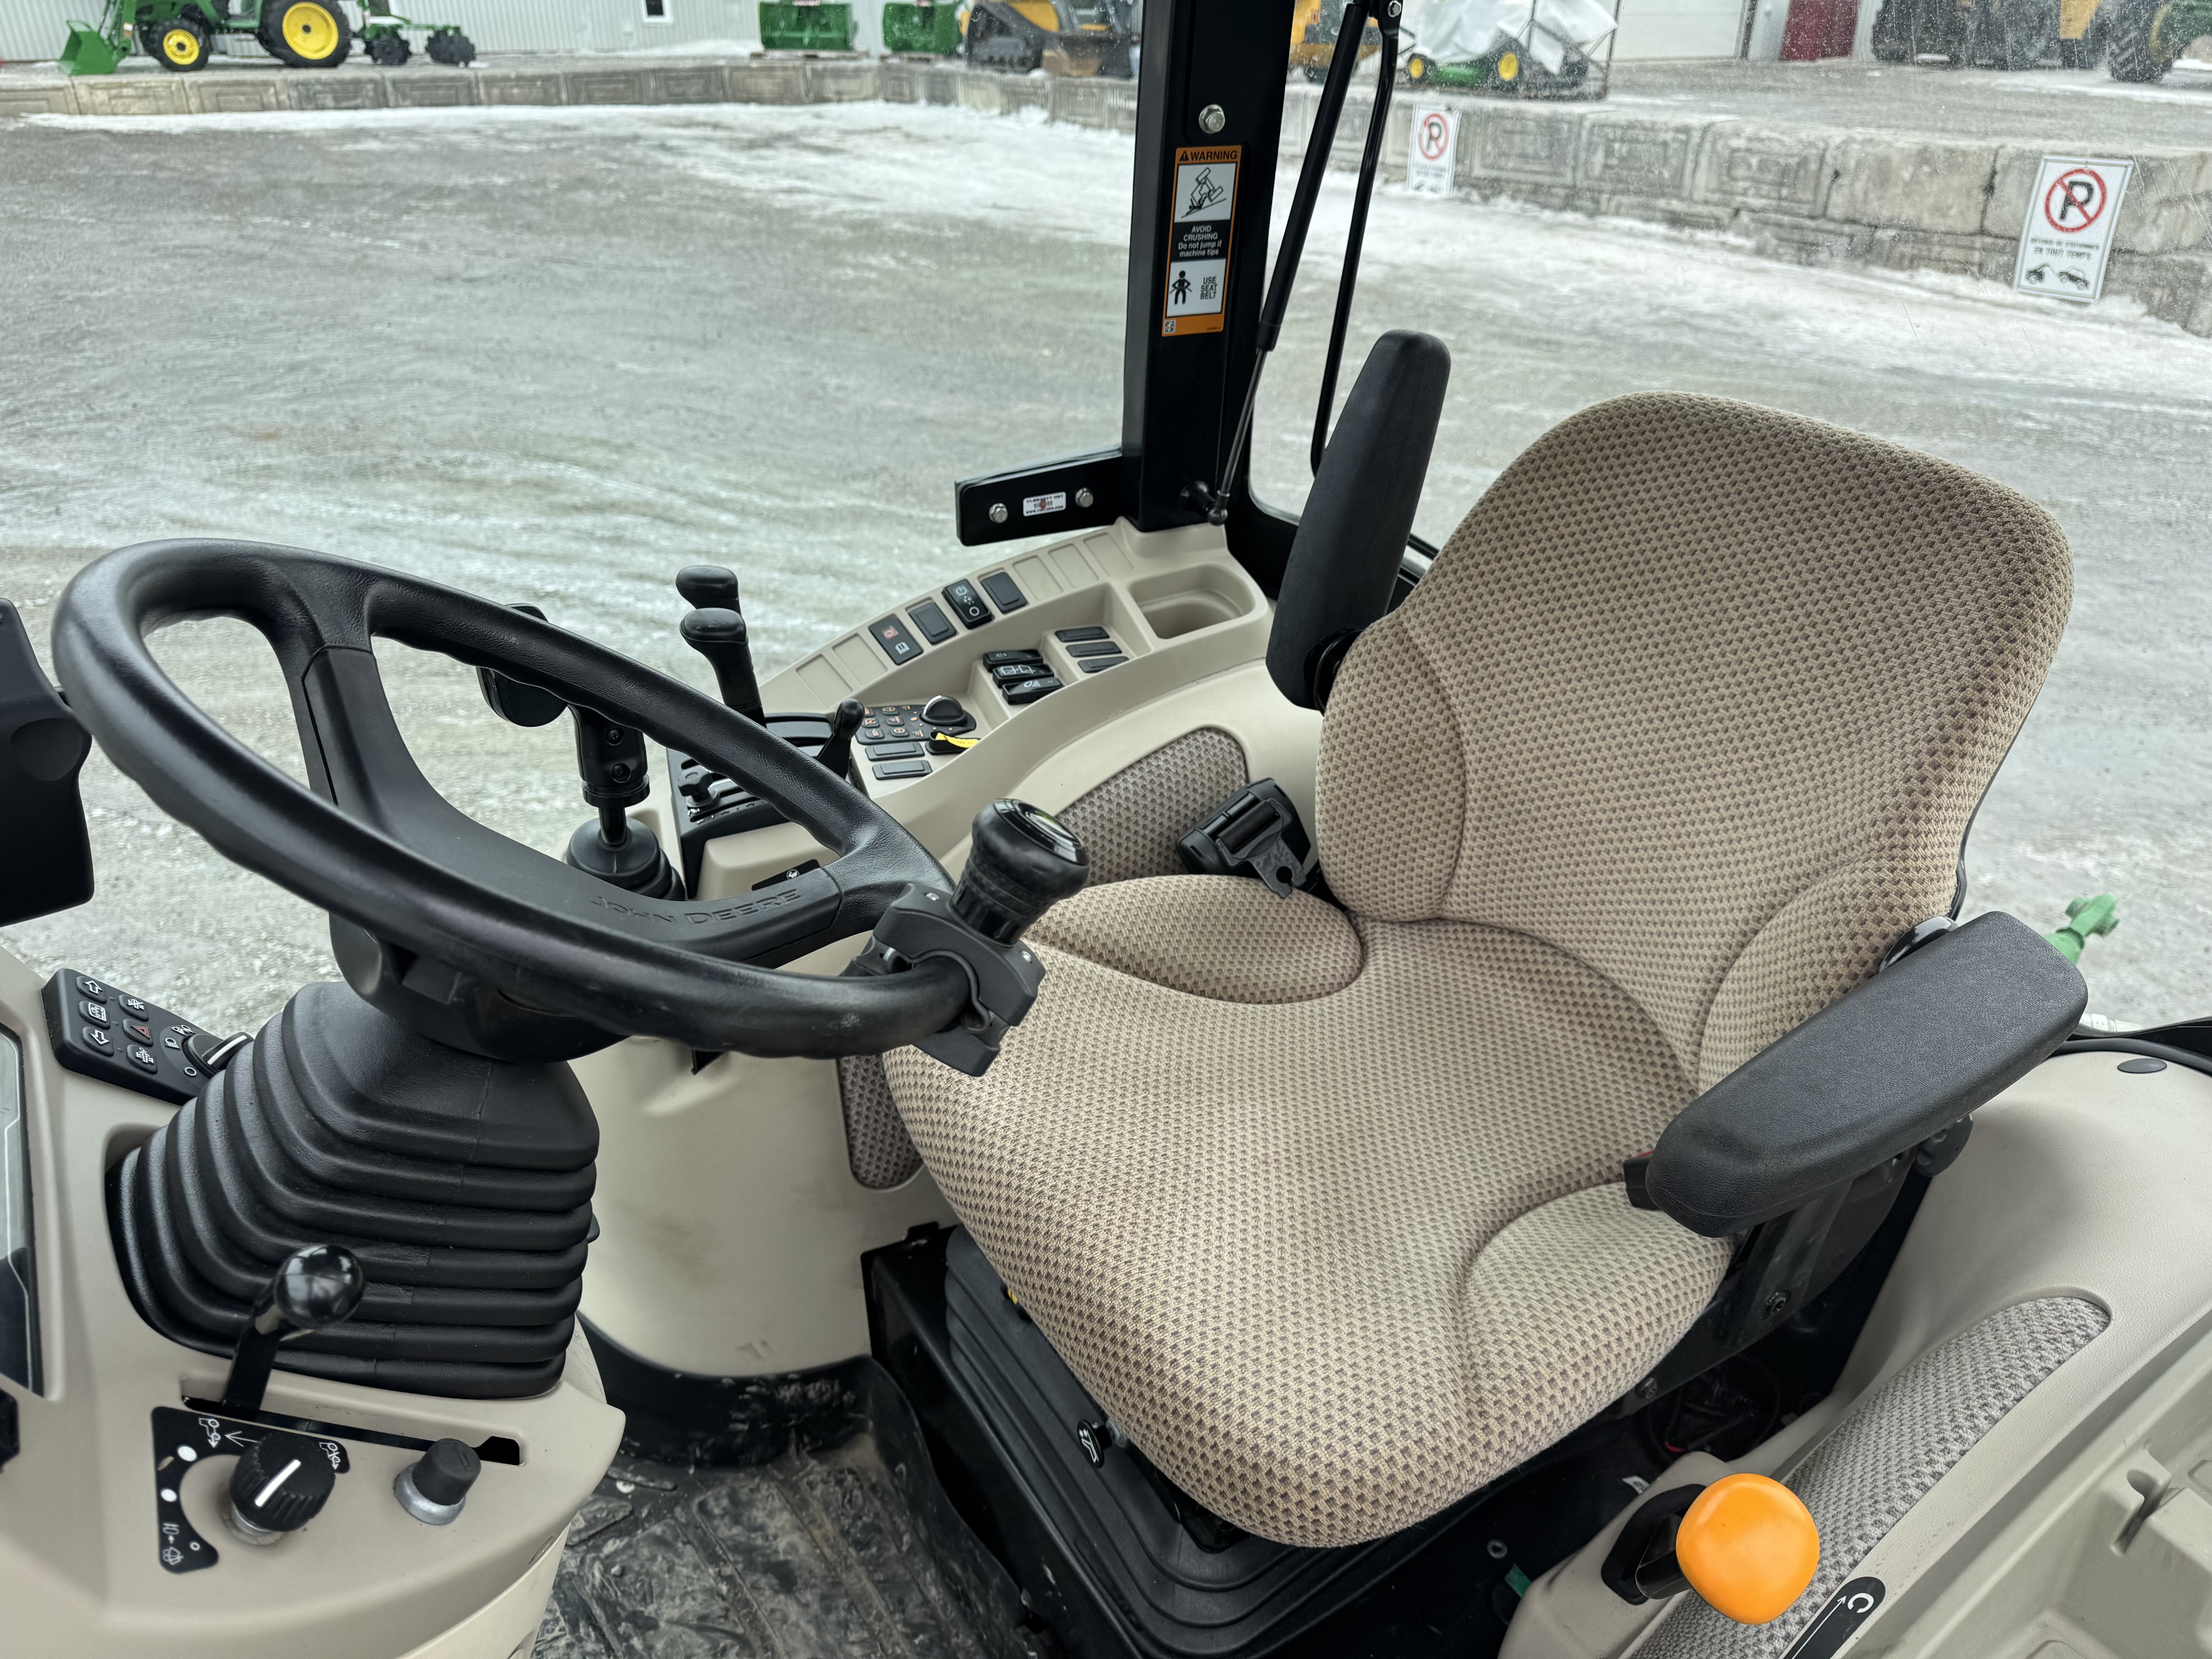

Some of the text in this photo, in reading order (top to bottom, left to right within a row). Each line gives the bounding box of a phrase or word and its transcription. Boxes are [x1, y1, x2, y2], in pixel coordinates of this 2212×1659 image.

[1190, 150, 1237, 161] WARNING
[1183, 232, 1218, 242] CRUSHING
[1188, 241, 1199, 249] not
[1200, 240, 1216, 250] jump
[1179, 248, 1219, 258] machine tips
[1203, 276, 1217, 285] USE
[1200, 284, 1218, 292] SEAT
[591, 888, 802, 924] JOHN DEERE
[1847, 1592, 1874, 1613] C
